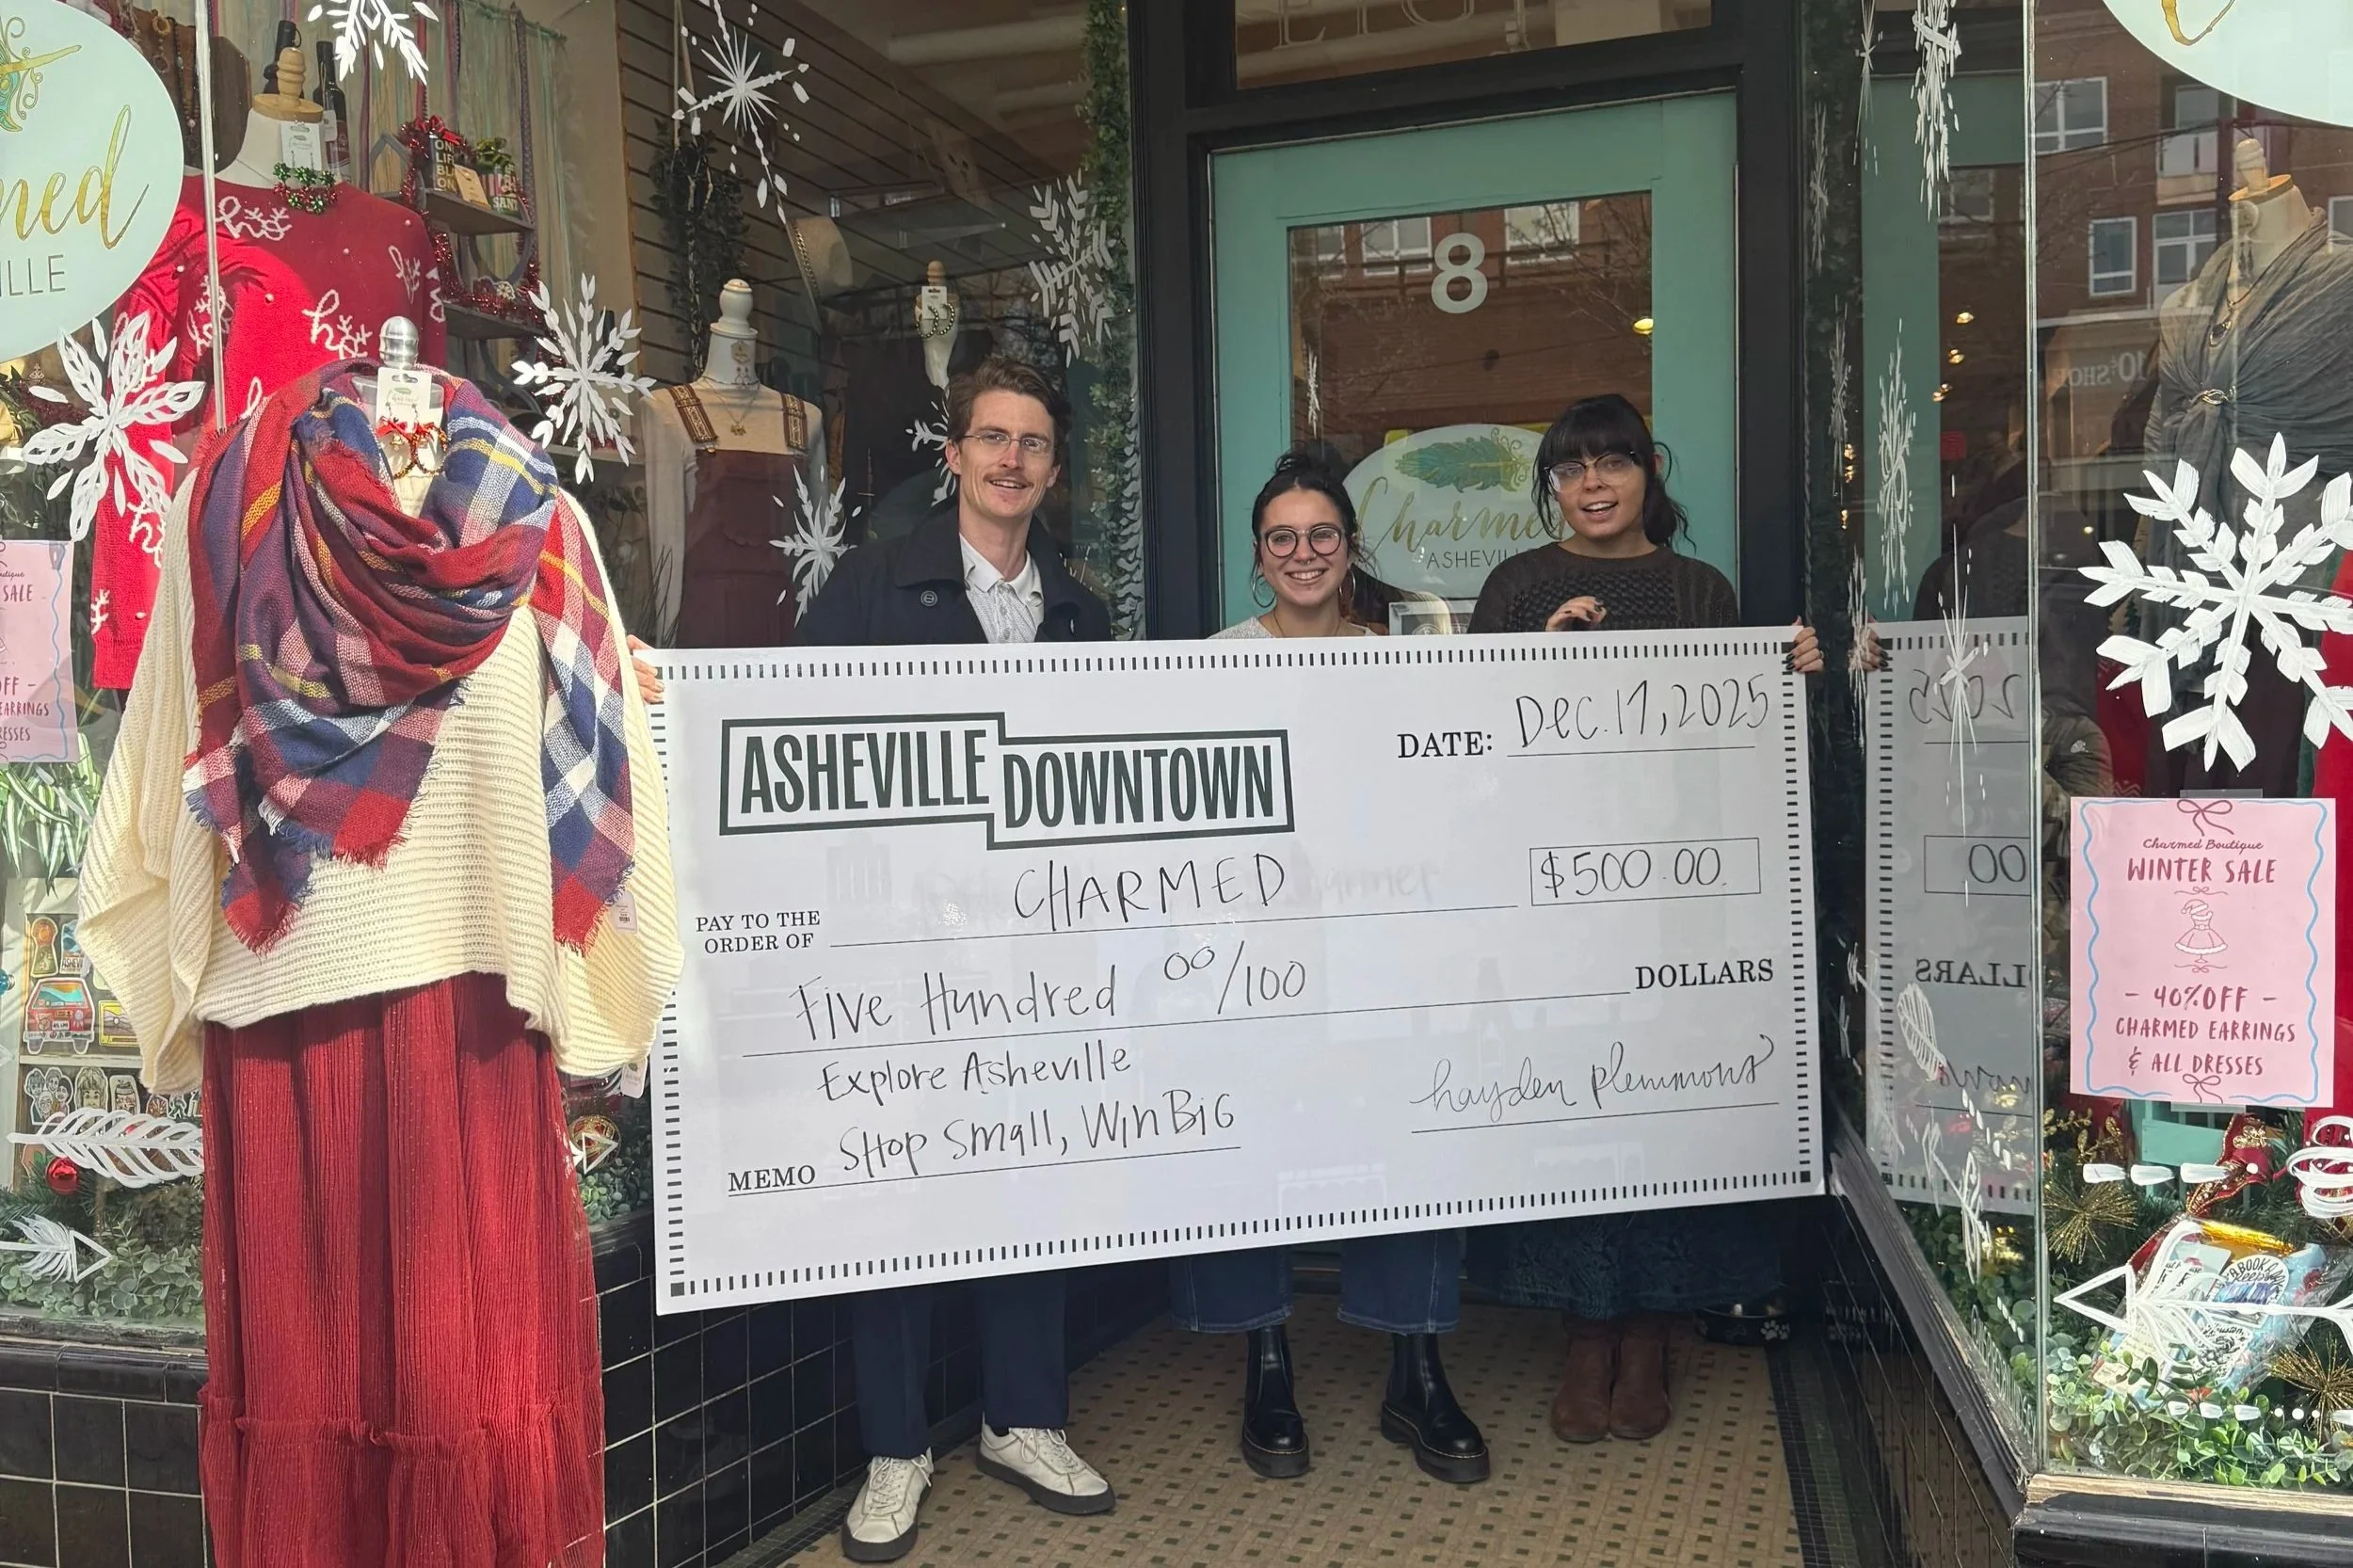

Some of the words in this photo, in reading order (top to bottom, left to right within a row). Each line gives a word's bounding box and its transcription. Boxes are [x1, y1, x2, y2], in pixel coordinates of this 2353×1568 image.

[1432, 232, 1488, 313] 8
[1427, 547, 1519, 570] ASHEVI
[3, 584, 33, 602] SALE
[0, 676, 19, 696] FF
[1397, 731, 1493, 759] DATE:
[740, 729, 989, 813] ASHEVILLE
[1003, 744, 1273, 828] DOWNTOWN
[2142, 837, 2203, 850] Charmed
[2204, 839, 2265, 855] Boutique
[2127, 857, 2212, 883] WINTER
[2224, 858, 2278, 885] SALE
[1015, 852, 1285, 931] CHARMED
[696, 915, 734, 932] PAY
[742, 913, 769, 929] TO
[776, 910, 821, 927] THE
[704, 936, 779, 953] ORDER
[786, 933, 814, 949] OF
[1635, 958, 1774, 990] DOLLARS
[789, 975, 892, 1041] Five
[920, 964, 1117, 1036] Hundred
[2116, 1016, 2199, 1039] CHARMED
[2208, 1020, 2296, 1043] EARRINGS
[817, 1060, 947, 1106] Explore
[962, 1039, 1131, 1093] Asheville
[2128, 1047, 2142, 1076] &
[2152, 1052, 2183, 1073] ALL
[2191, 1053, 2264, 1076] DRESSES
[728, 1165, 817, 1192] MEMO
[2237, 1257, 2270, 1274] BOOK
